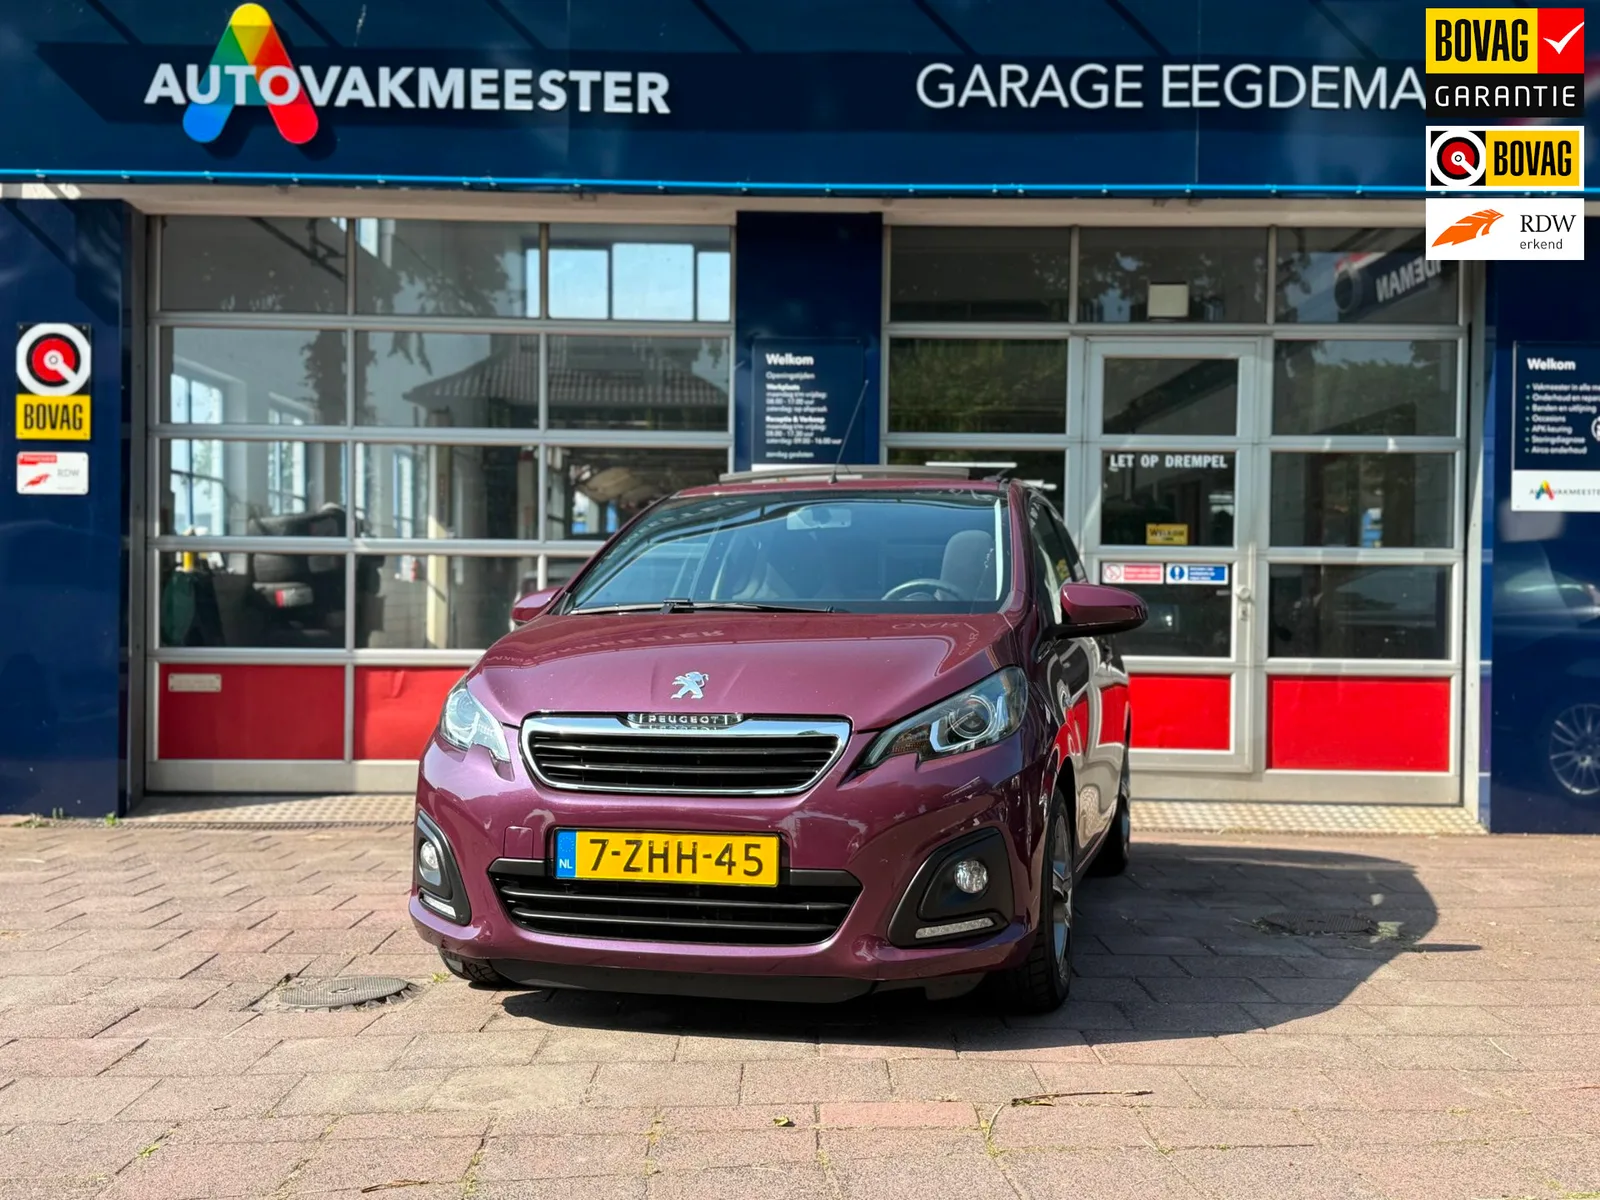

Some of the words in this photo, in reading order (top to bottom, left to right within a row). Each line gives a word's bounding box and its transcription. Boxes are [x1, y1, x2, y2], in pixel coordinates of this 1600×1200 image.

[144, 63, 671, 114] AUTOVAKMEESTER
[916, 63, 1144, 108] GARAGE
[765, 353, 814, 366] Welkom
[1527, 358, 1576, 371] Welkom
[24, 404, 83, 430] BOVAG
[1110, 454, 1134, 468] LET
[1141, 455, 1159, 468] OP
[1165, 455, 1228, 469] DREMPEL
[648, 714, 719, 724] PEUGEOT
[559, 858, 572, 869] NL
[589, 838, 763, 877] 7-ZHH-45
